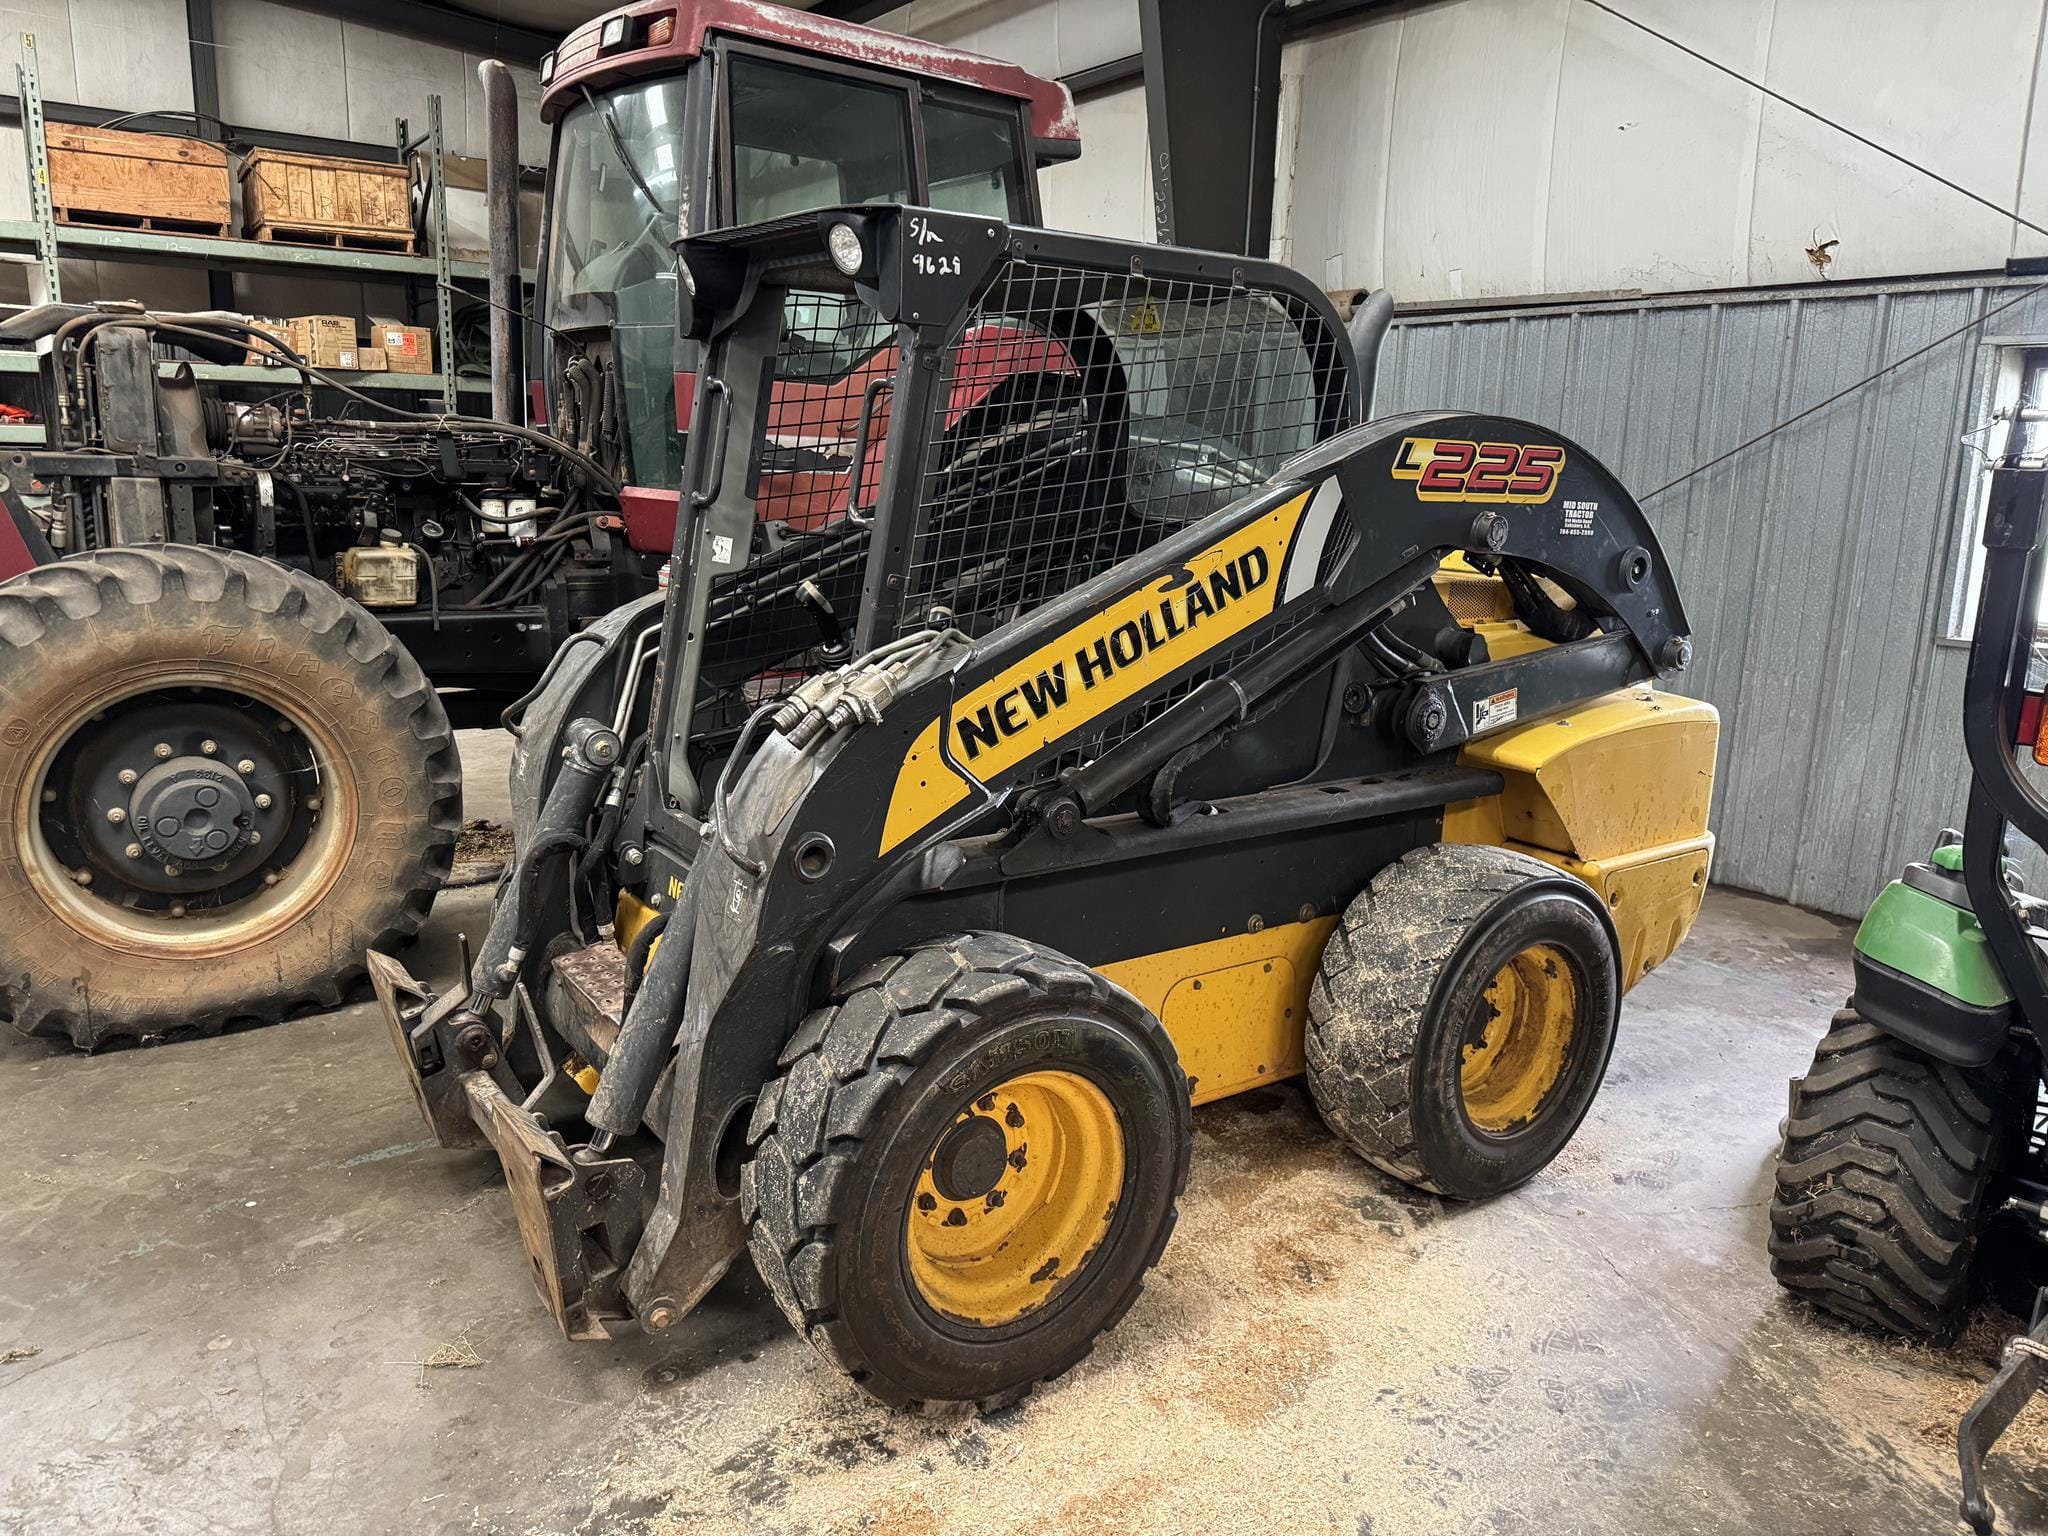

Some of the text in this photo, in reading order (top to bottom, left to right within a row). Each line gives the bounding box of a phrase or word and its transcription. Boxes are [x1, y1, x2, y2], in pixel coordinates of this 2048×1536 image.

[26, 33, 32, 47] 5
[39, 169, 45, 182] 4
[1393, 439, 1565, 497] L225
[1563, 500, 1598, 510] MID SOUTH
[1565, 510, 1594, 519] TRACTOR
[955, 546, 1270, 760] NEW HOLLAND
[201, 624, 409, 890] Firestone
[668, 875, 685, 901] NE
[950, 1028, 1077, 1093] SAMSON
